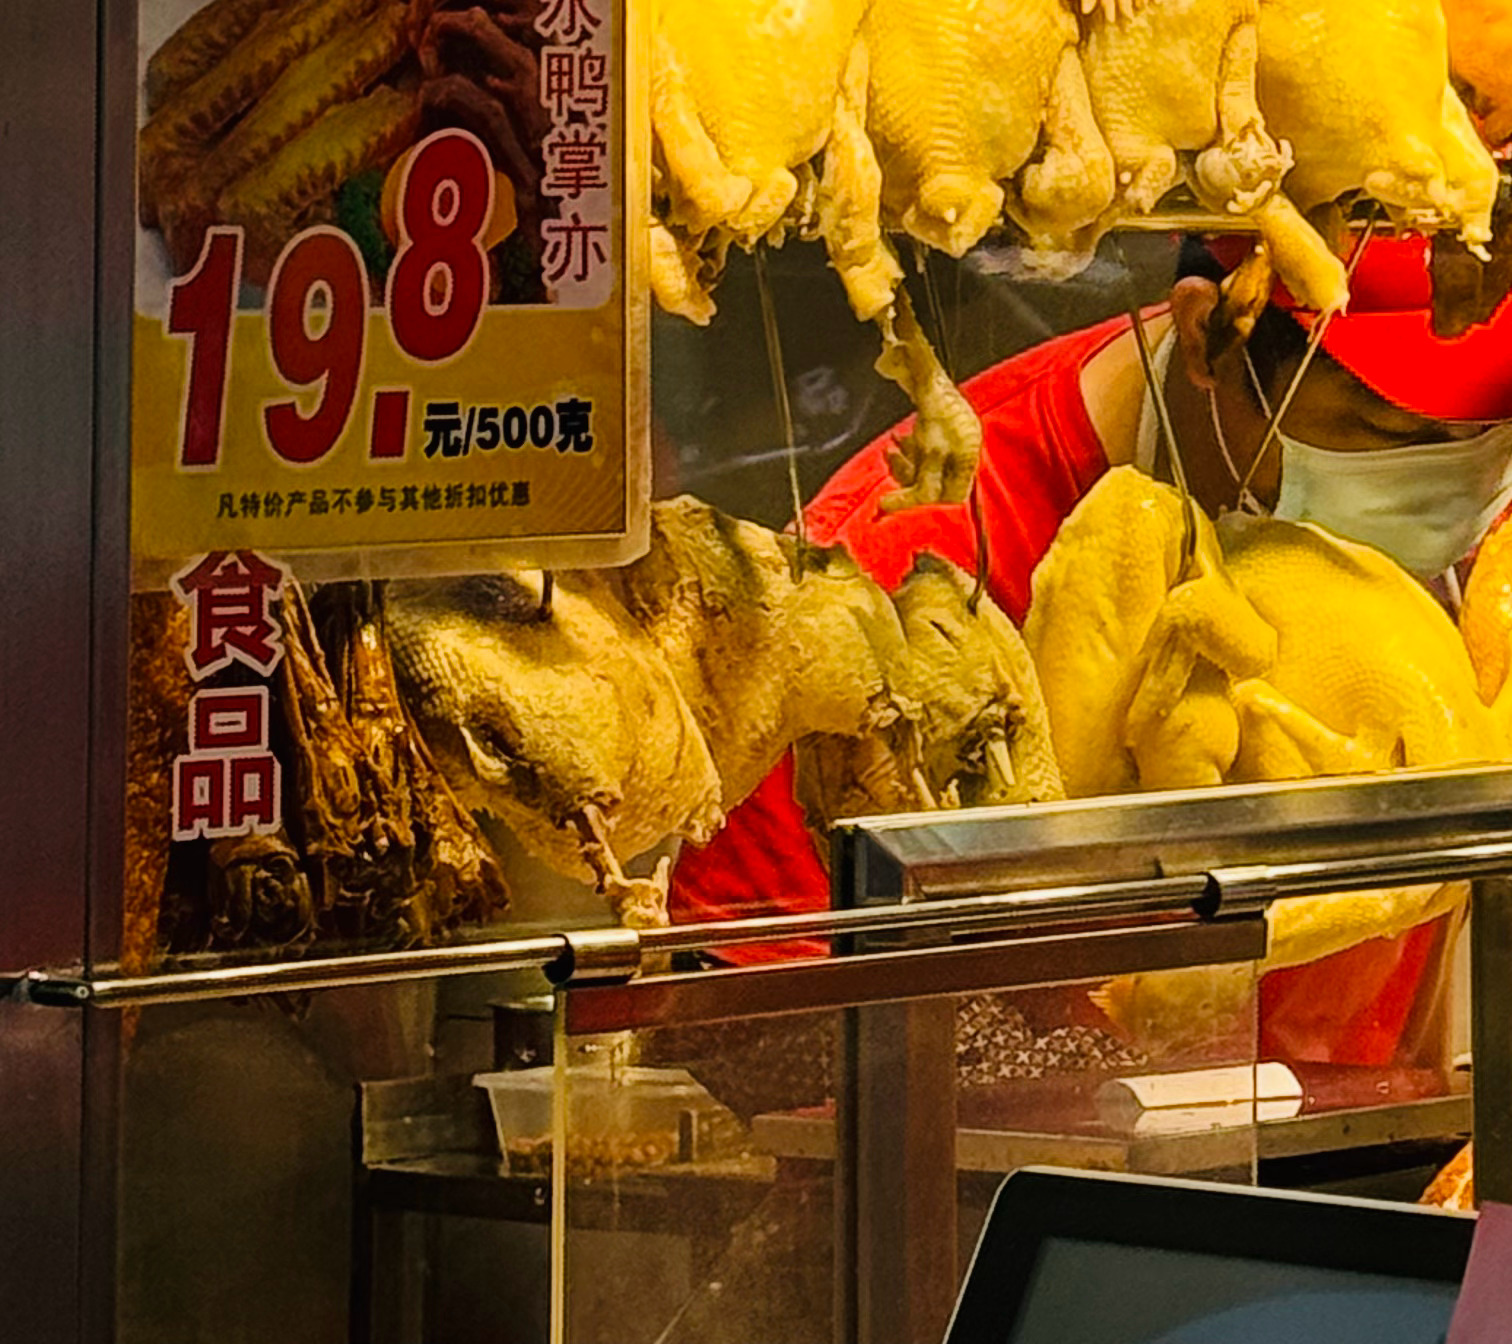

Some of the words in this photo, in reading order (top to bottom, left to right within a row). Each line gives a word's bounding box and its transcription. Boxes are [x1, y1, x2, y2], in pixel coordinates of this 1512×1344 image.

[167, 133, 492, 467] 19.8
[216, 480, 531, 519] 凡特价产品不参与其他折扣优惠
[424, 398, 594, 458] 元/500克
[172, 550, 284, 840] 食品
